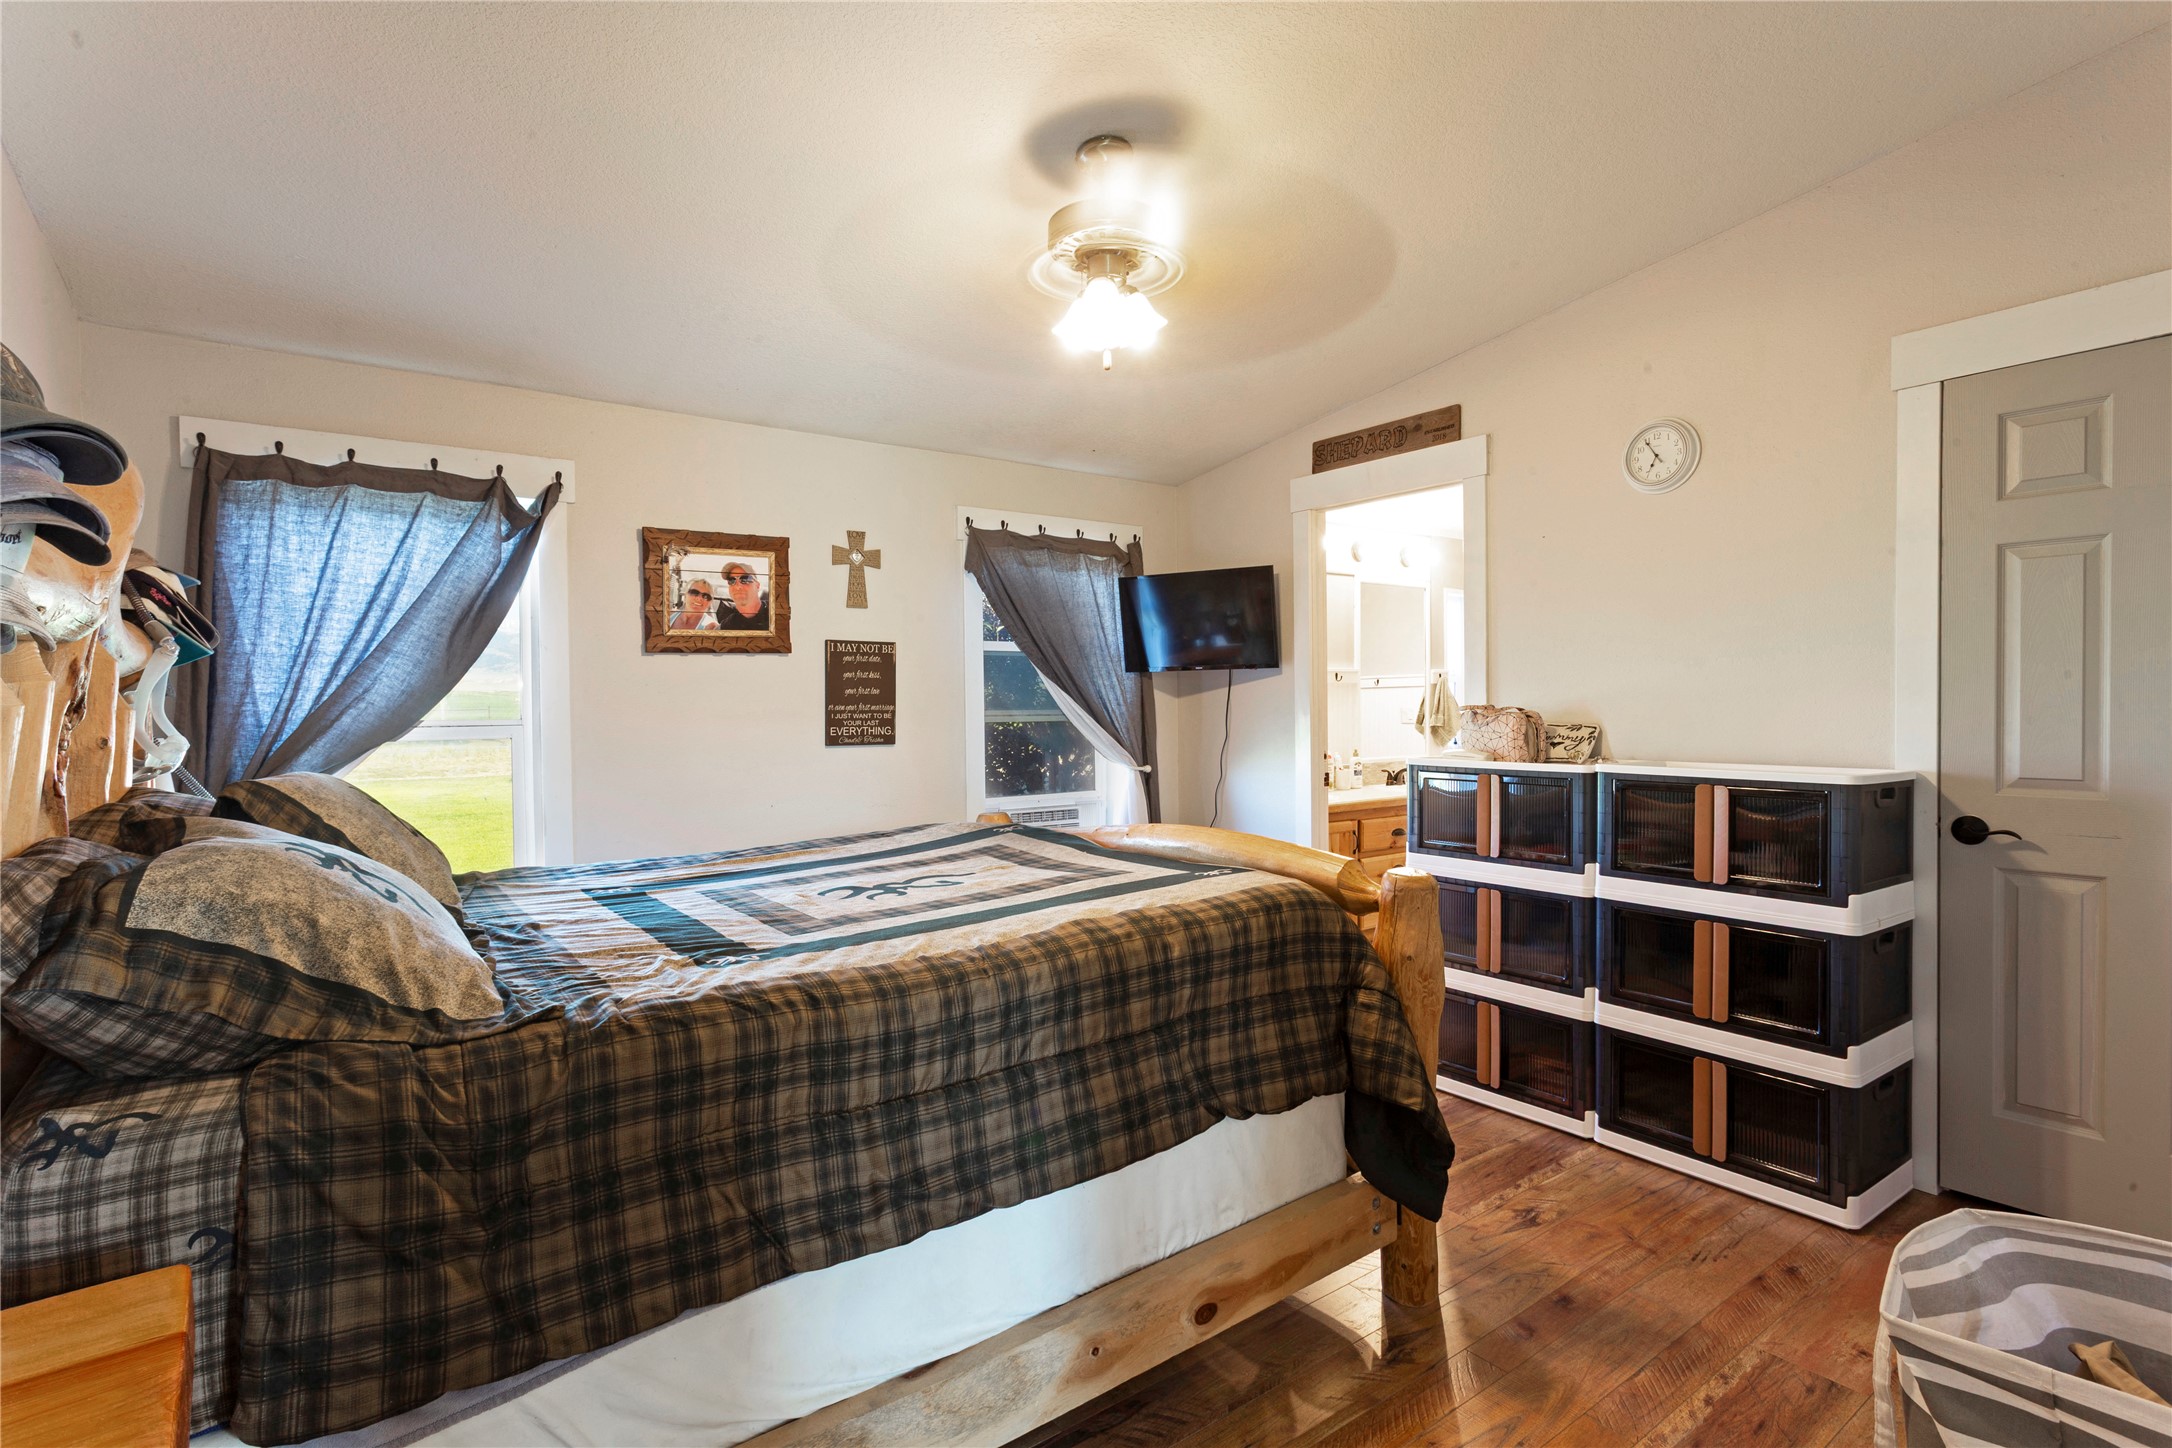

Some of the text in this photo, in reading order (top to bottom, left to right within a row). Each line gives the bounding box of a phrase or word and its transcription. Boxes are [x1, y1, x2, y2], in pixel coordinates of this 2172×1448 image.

[1653, 432, 1661, 440] 12
[1314, 425, 1408, 466] SHEPARD
[831, 642, 894, 653] I MAY NOT BE
[842, 656, 854, 664] your
[854, 653, 869, 664] first
[842, 670, 881, 680] your first kiss,
[845, 688, 857, 696] your
[856, 686, 870, 697] first
[846, 704, 857, 713] your
[857, 702, 871, 713] first
[830, 726, 894, 736] EVERYTHING.
